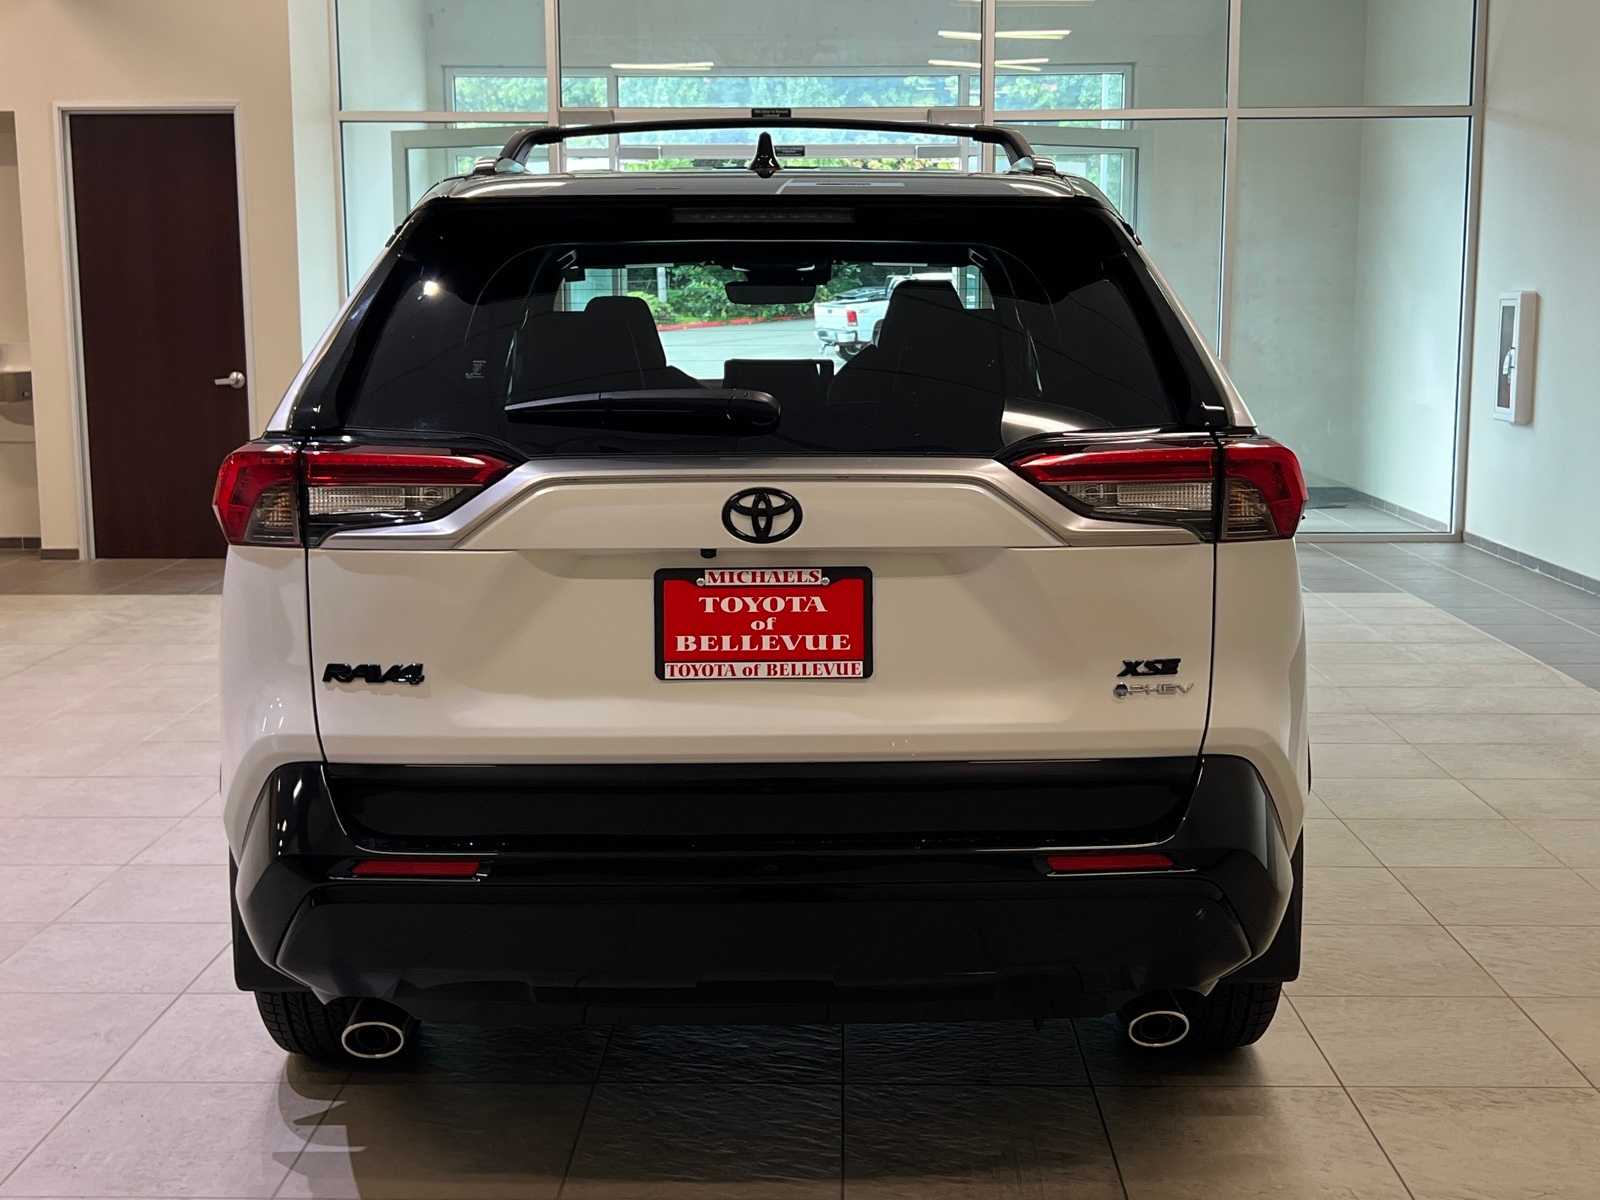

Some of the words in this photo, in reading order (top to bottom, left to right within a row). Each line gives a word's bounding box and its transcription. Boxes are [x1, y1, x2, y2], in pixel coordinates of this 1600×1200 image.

[707, 569, 820, 584] MICHAELS
[698, 596, 828, 613] TOYOTA
[750, 617, 777, 631] of
[674, 633, 851, 652] BELLEVUE
[322, 663, 425, 685] RAV4
[666, 663, 737, 678] TOYOTA
[742, 662, 759, 677] of
[766, 661, 862, 677] BELLEVUE
[1117, 658, 1181, 677] XSE
